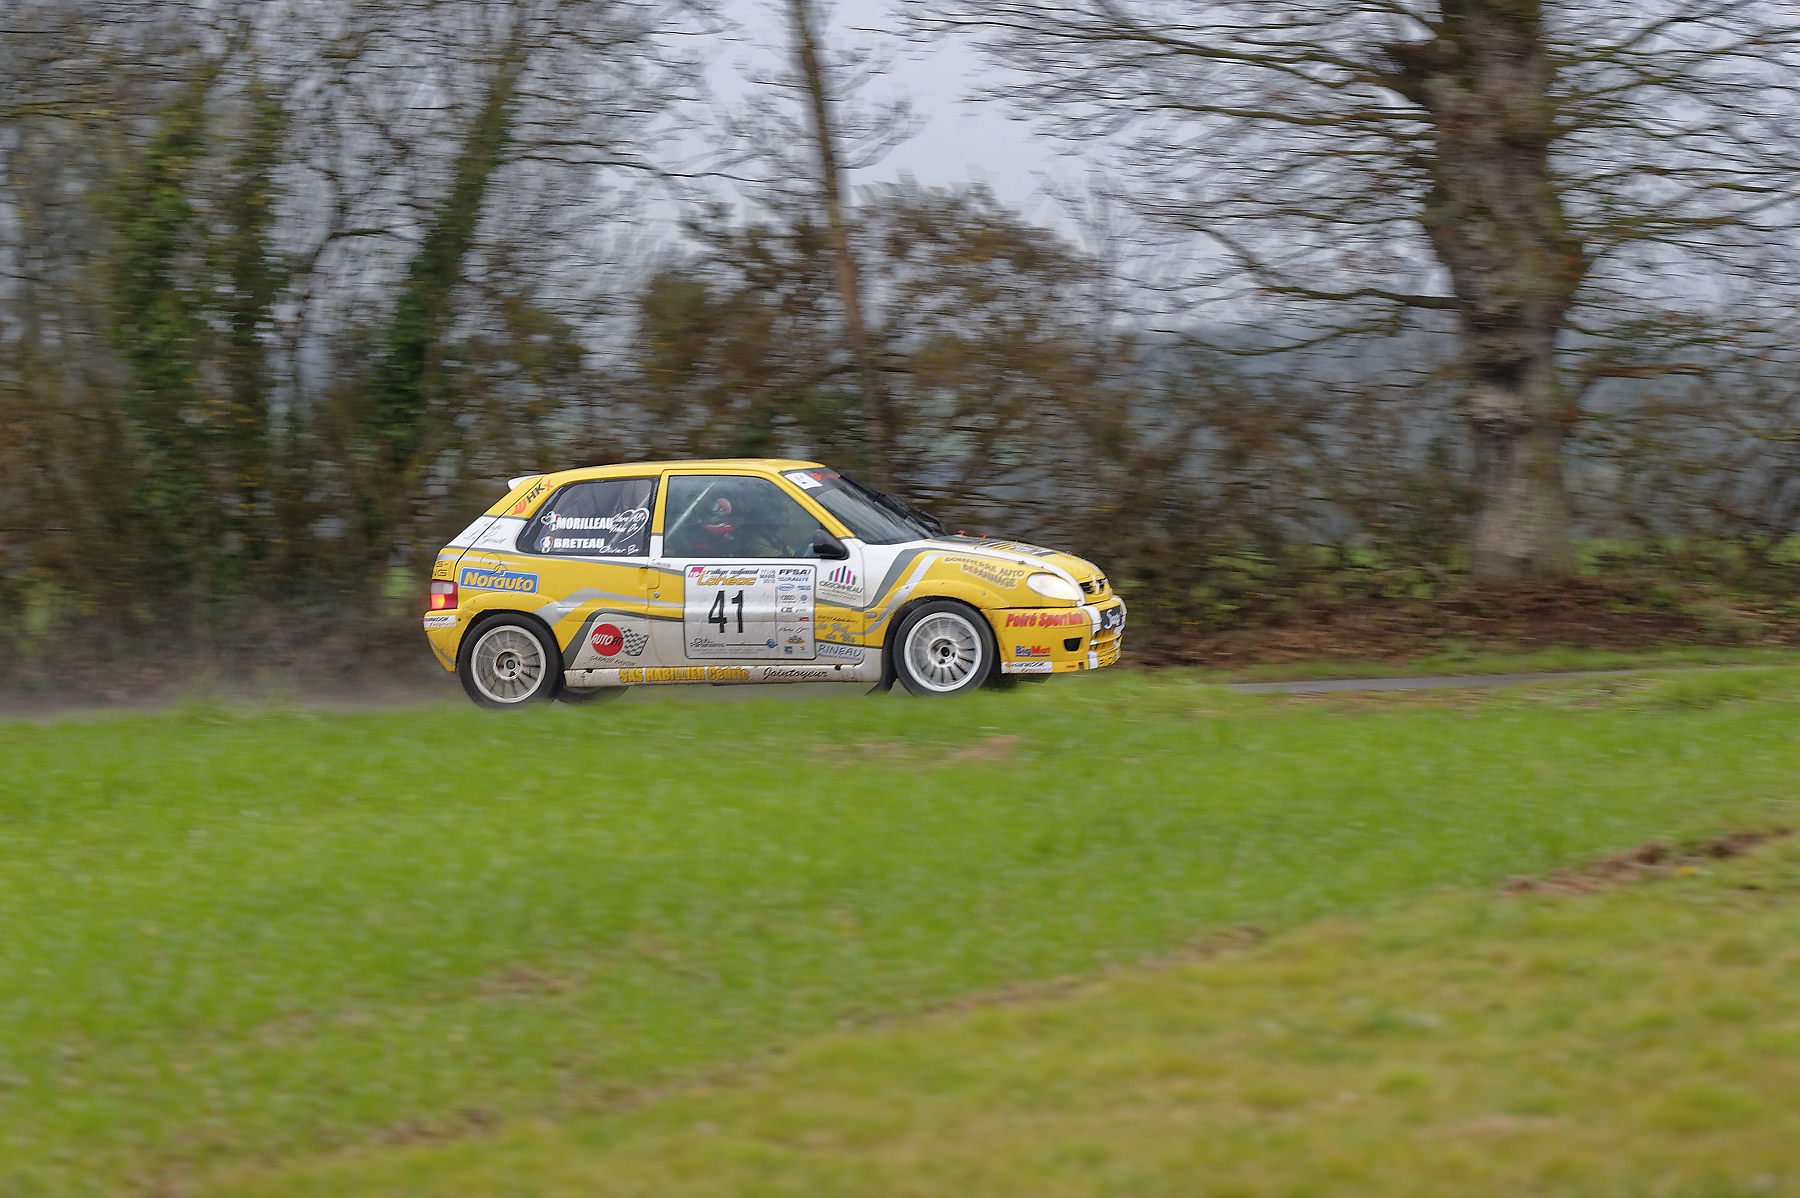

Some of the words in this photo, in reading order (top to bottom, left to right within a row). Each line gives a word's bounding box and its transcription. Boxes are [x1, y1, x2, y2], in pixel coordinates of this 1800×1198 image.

[556, 517, 614, 530] MORILLEAU
[553, 538, 605, 549] BRETEAU
[463, 571, 534, 592] Norauto
[697, 570, 757, 586] Lohéac
[708, 590, 744, 633] 41
[1006, 612, 1037, 627] Poiré
[819, 644, 862, 657] RINEAU
[1016, 645, 1051, 657] BigMat
[619, 667, 643, 683] SAS
